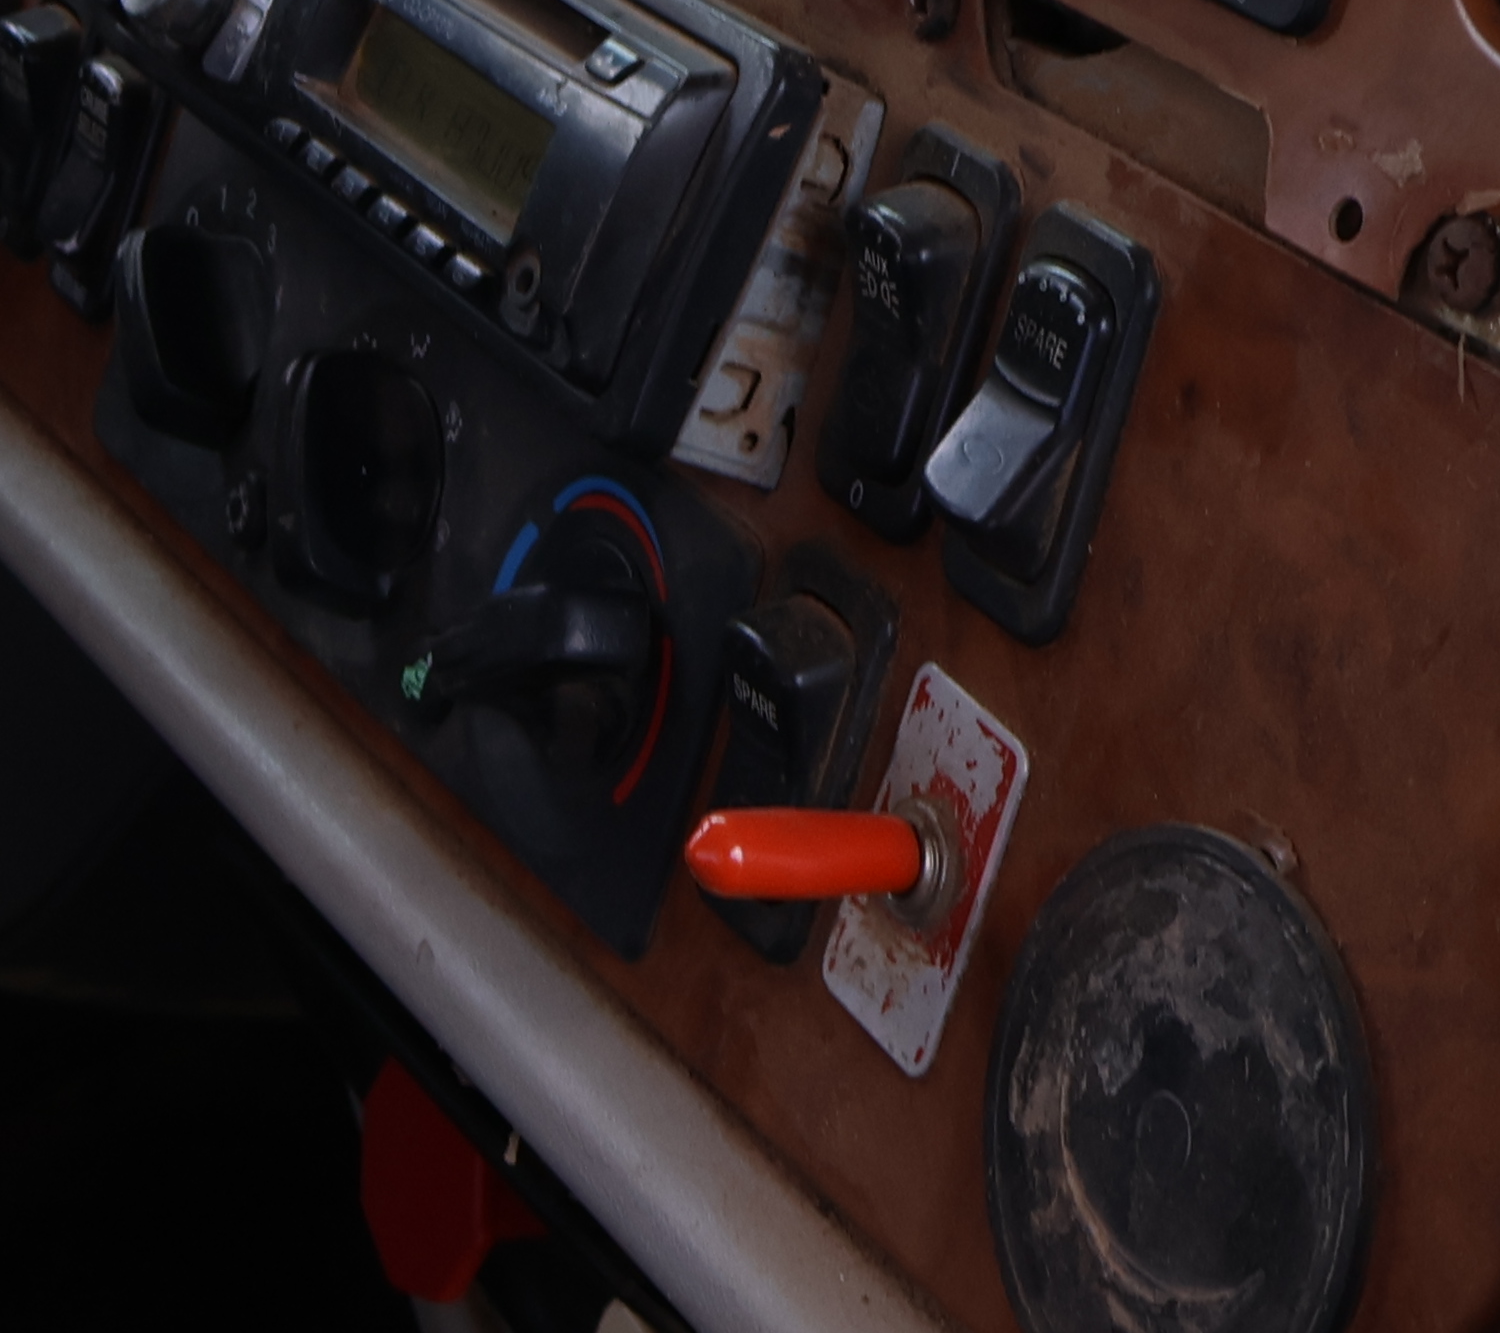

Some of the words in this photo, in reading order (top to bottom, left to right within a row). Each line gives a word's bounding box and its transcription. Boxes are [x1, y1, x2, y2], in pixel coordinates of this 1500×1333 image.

[220, 183, 227, 213] 1
[246, 187, 257, 220] 2
[267, 223, 277, 254] 3
[864, 245, 889, 279] AUX
[1014, 313, 1068, 371] SPARE
[733, 672, 779, 732] SPARE
